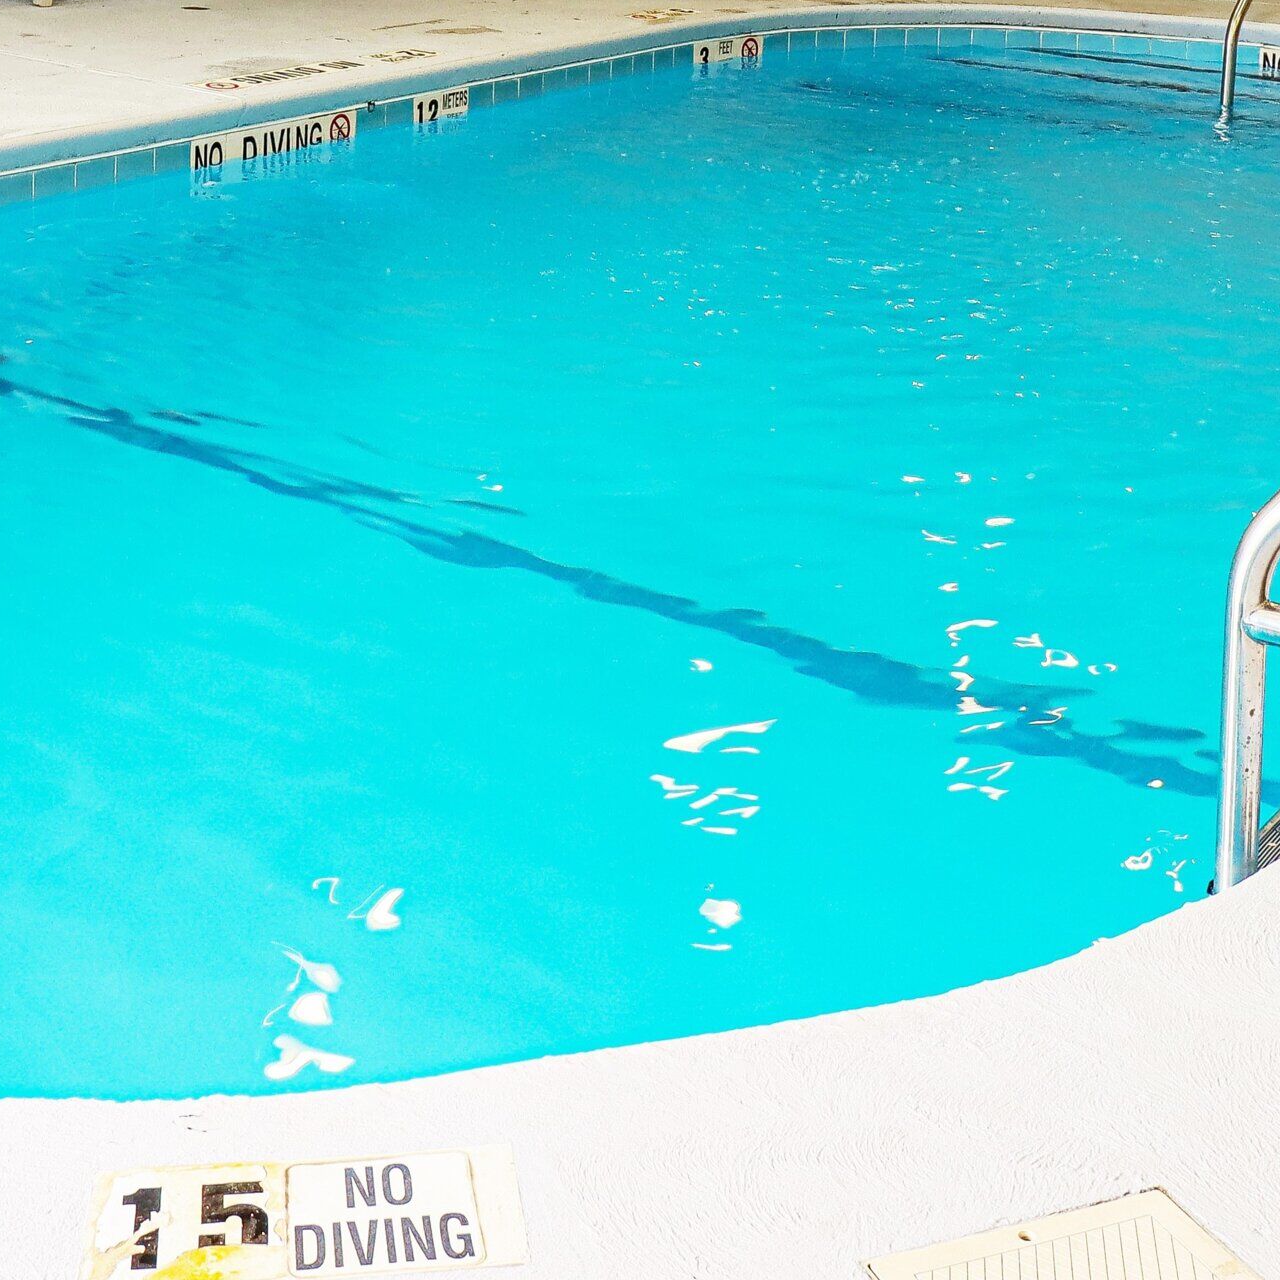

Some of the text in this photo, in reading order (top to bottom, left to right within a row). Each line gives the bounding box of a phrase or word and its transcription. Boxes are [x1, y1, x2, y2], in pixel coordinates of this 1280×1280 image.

[719, 40, 733, 55] FEET
[442, 90, 467, 110] METERS
[195, 122, 322, 170] NO DIVING
[344, 1163, 413, 1209] NO
[294, 1213, 476, 1271] DIVING
